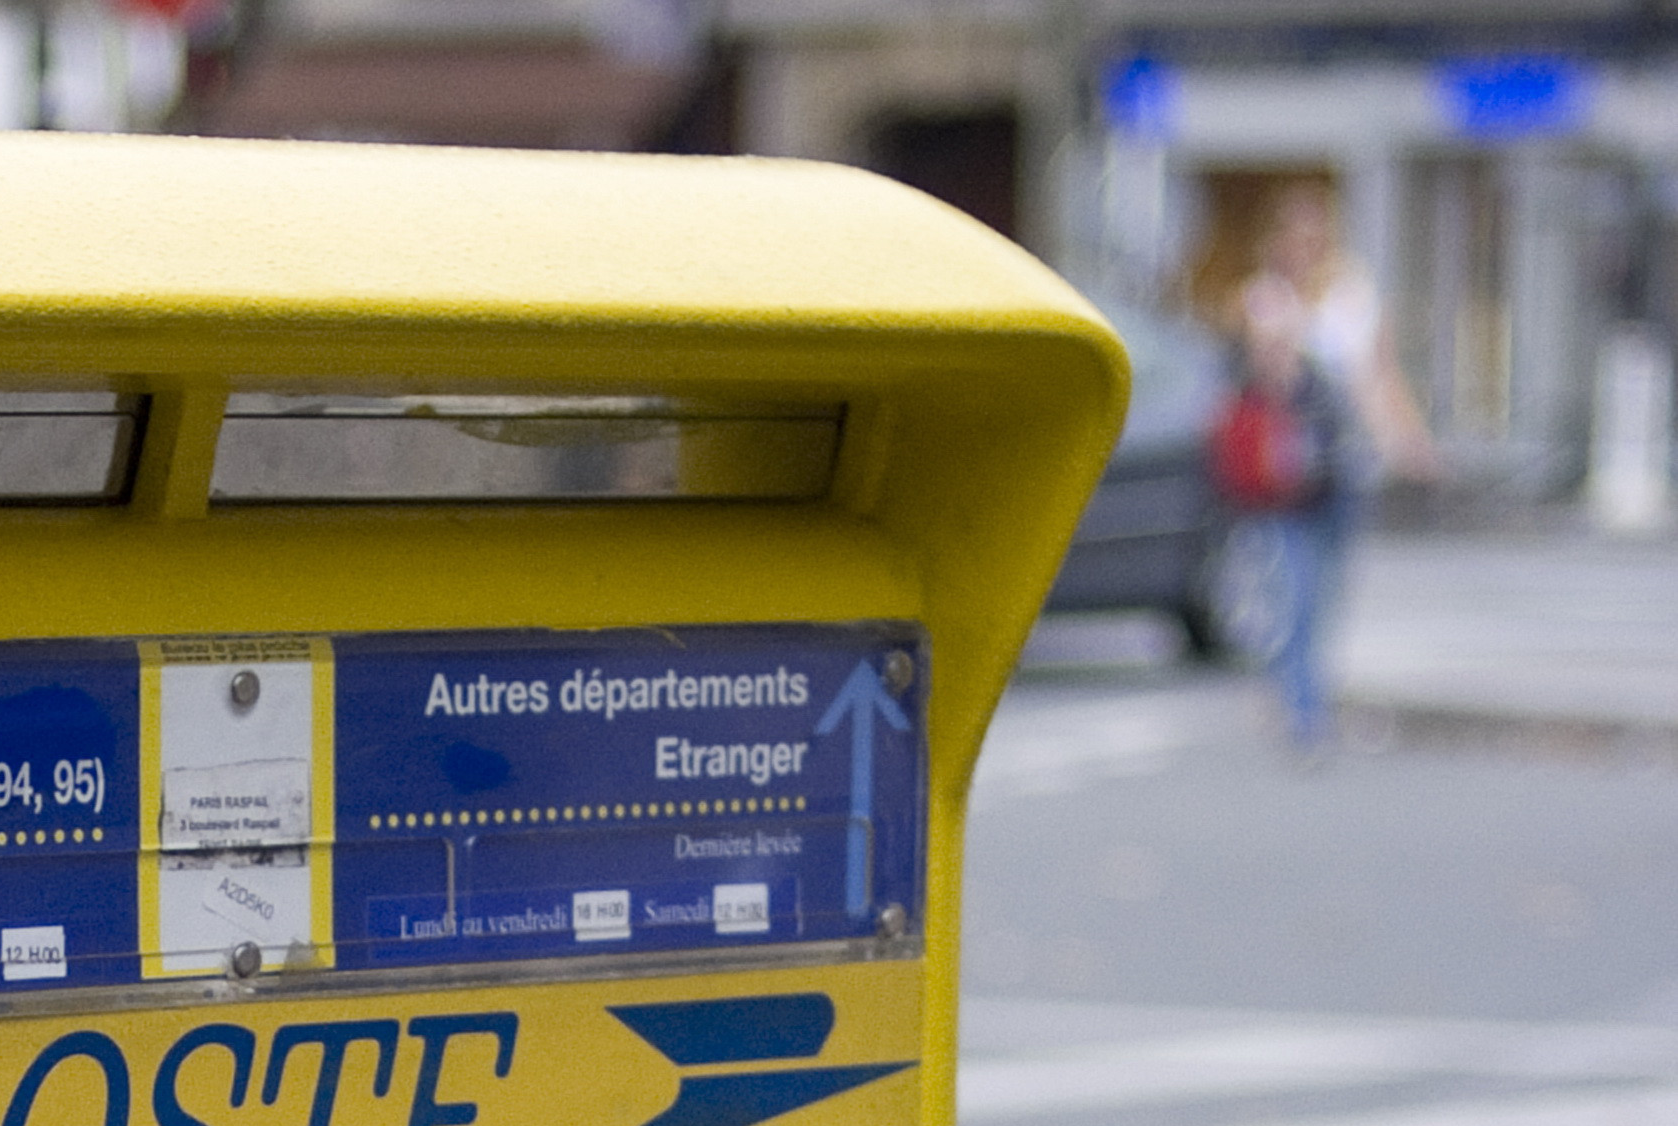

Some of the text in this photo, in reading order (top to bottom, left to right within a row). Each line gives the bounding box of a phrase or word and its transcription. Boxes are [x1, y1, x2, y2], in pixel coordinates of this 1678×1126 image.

[424, 666, 808, 721] Autres départements
[655, 735, 808, 785] Etranger
[54, 757, 106, 813] 95)
[190, 797, 222, 808] PARIS
[675, 830, 803, 860] Dernière levée
[462, 917, 483, 935] au
[487, 906, 568, 934] vendredi
[644, 899, 709, 923] Samedi
